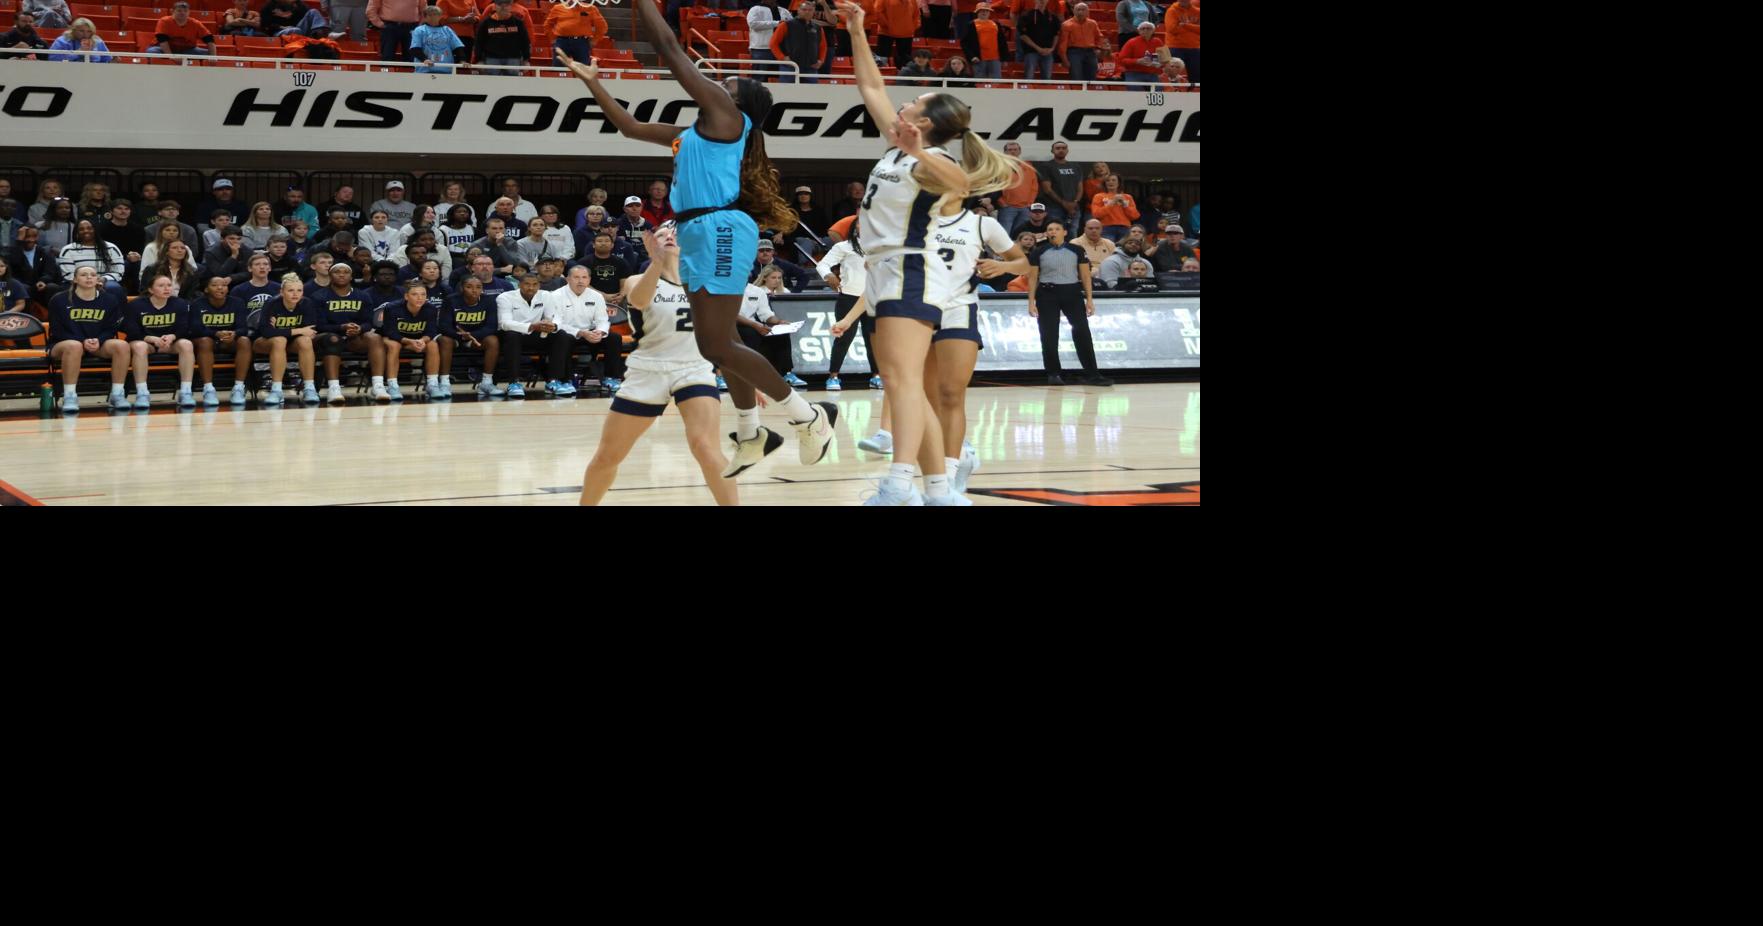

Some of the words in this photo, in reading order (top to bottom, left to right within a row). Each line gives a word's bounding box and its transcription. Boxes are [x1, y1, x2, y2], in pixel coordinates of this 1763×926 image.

[293, 72, 316, 87] 107
[0, 85, 73, 118] O
[1146, 93, 1164, 106] 108
[762, 102, 1200, 143] GAAGH
[449, 235, 475, 245] ORU
[934, 234, 967, 246] Roberts
[714, 226, 733, 278] COWGIRLS
[654, 294, 676, 304] Oral
[677, 294, 689, 304] R
[329, 300, 362, 311] ORU
[70, 308, 105, 320] ORU
[142, 312, 176, 326] ORU
[202, 312, 235, 325] ORU
[455, 310, 486, 322] ORU
[676, 308, 694, 331] 2
[276, 315, 303, 327] ORU
[397, 320, 427, 332] ORU
